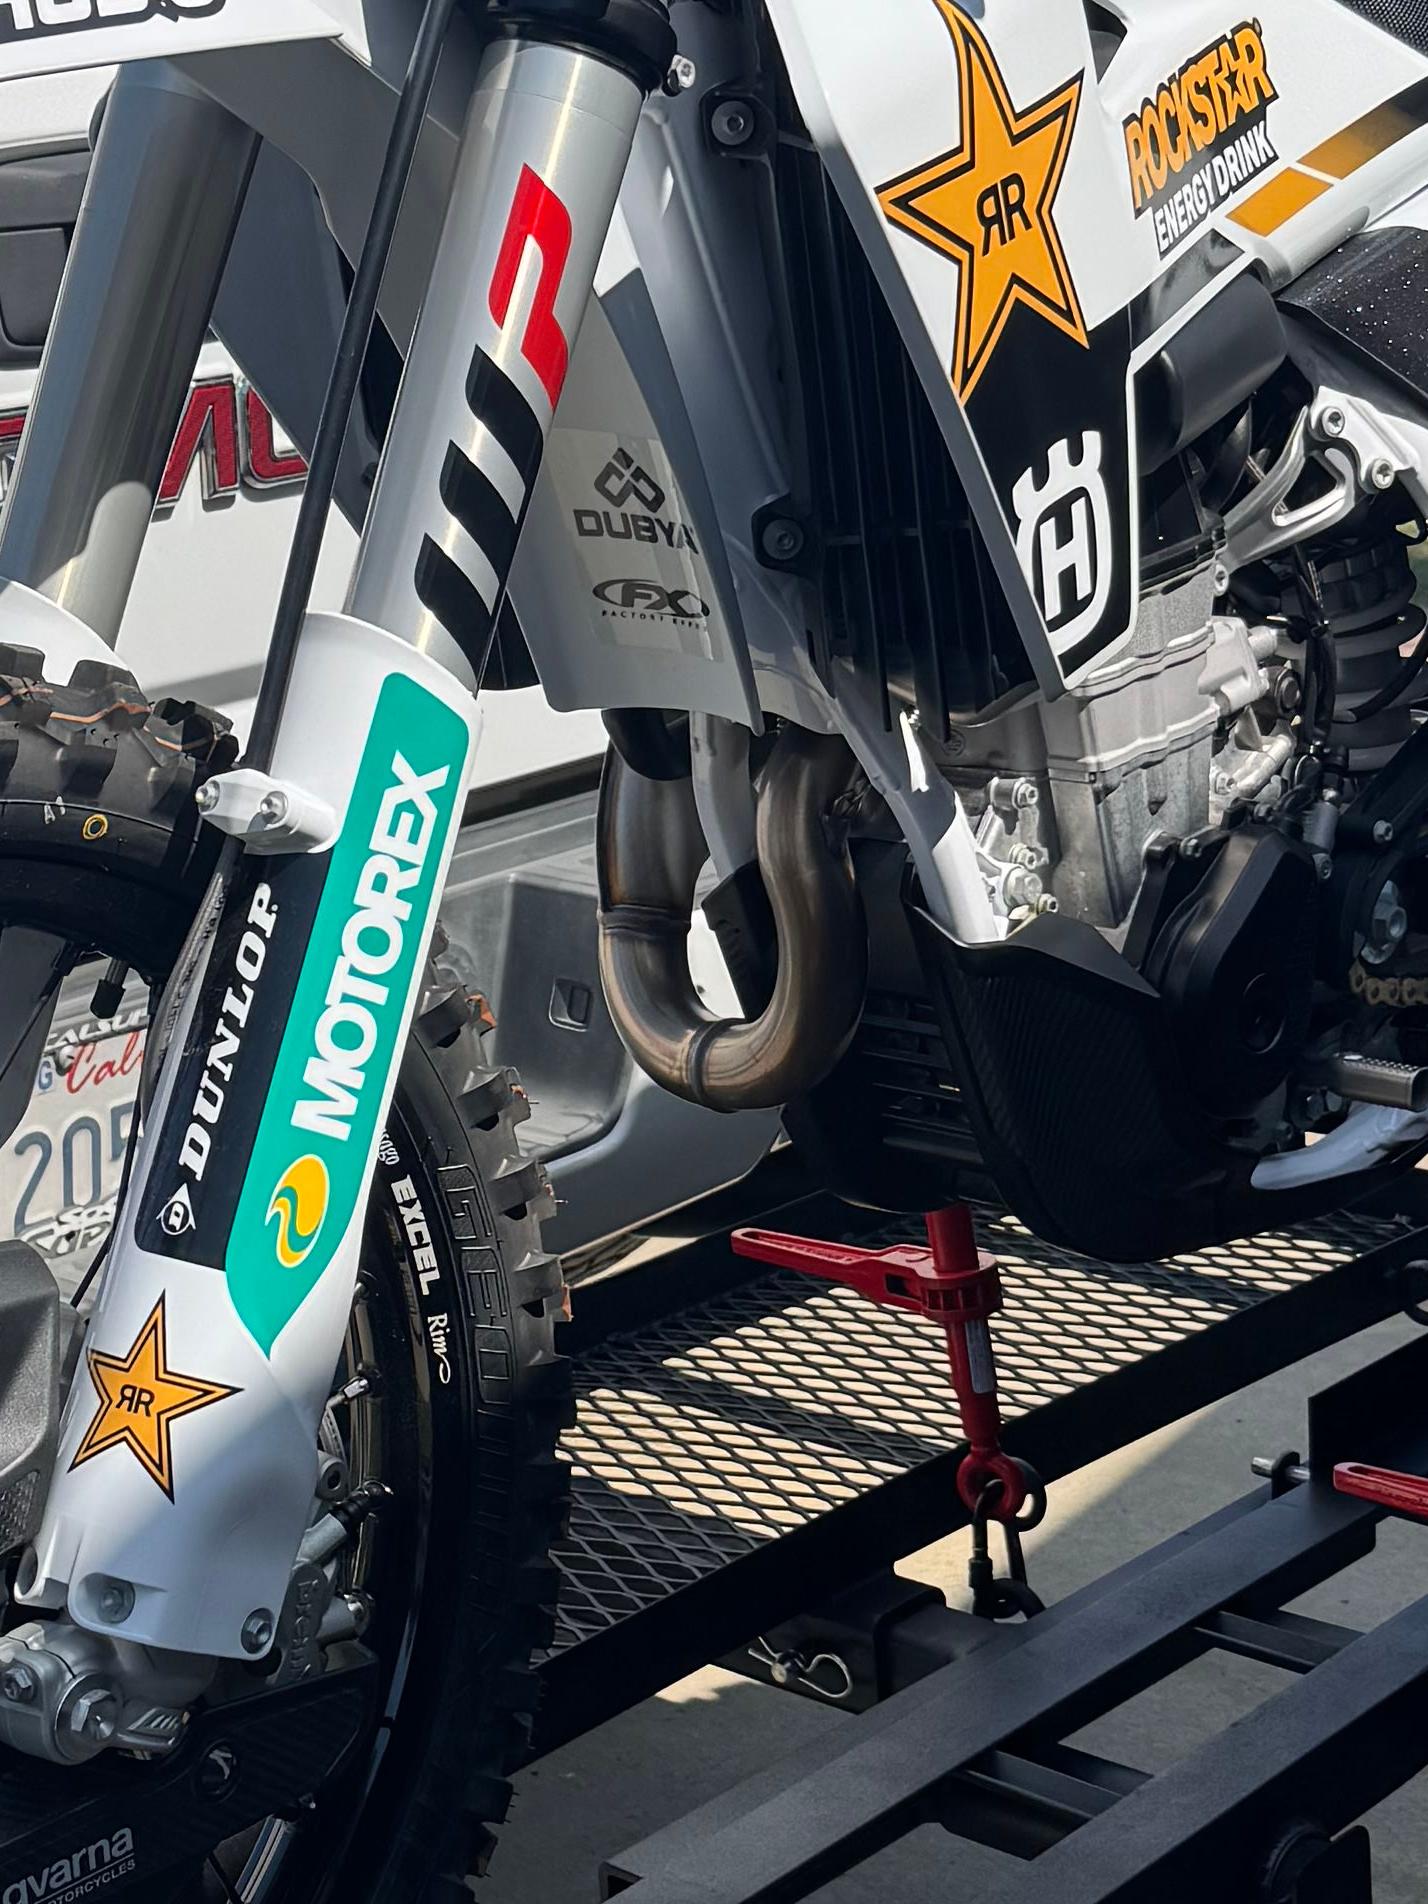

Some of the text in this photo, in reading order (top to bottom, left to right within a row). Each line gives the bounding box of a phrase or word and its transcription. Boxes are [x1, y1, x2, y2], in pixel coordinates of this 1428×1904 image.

[1125, 27, 1275, 209] ROCKSTAR
[1154, 120, 1275, 254] ENERGY DRINK
[573, 509, 699, 555] DUBYA
[291, 749, 452, 1143] MOTOREX
[178, 881, 280, 1183] DUNLOP
[390, 1174, 441, 1296] EXCEL
[427, 1312, 451, 1384] Rim
